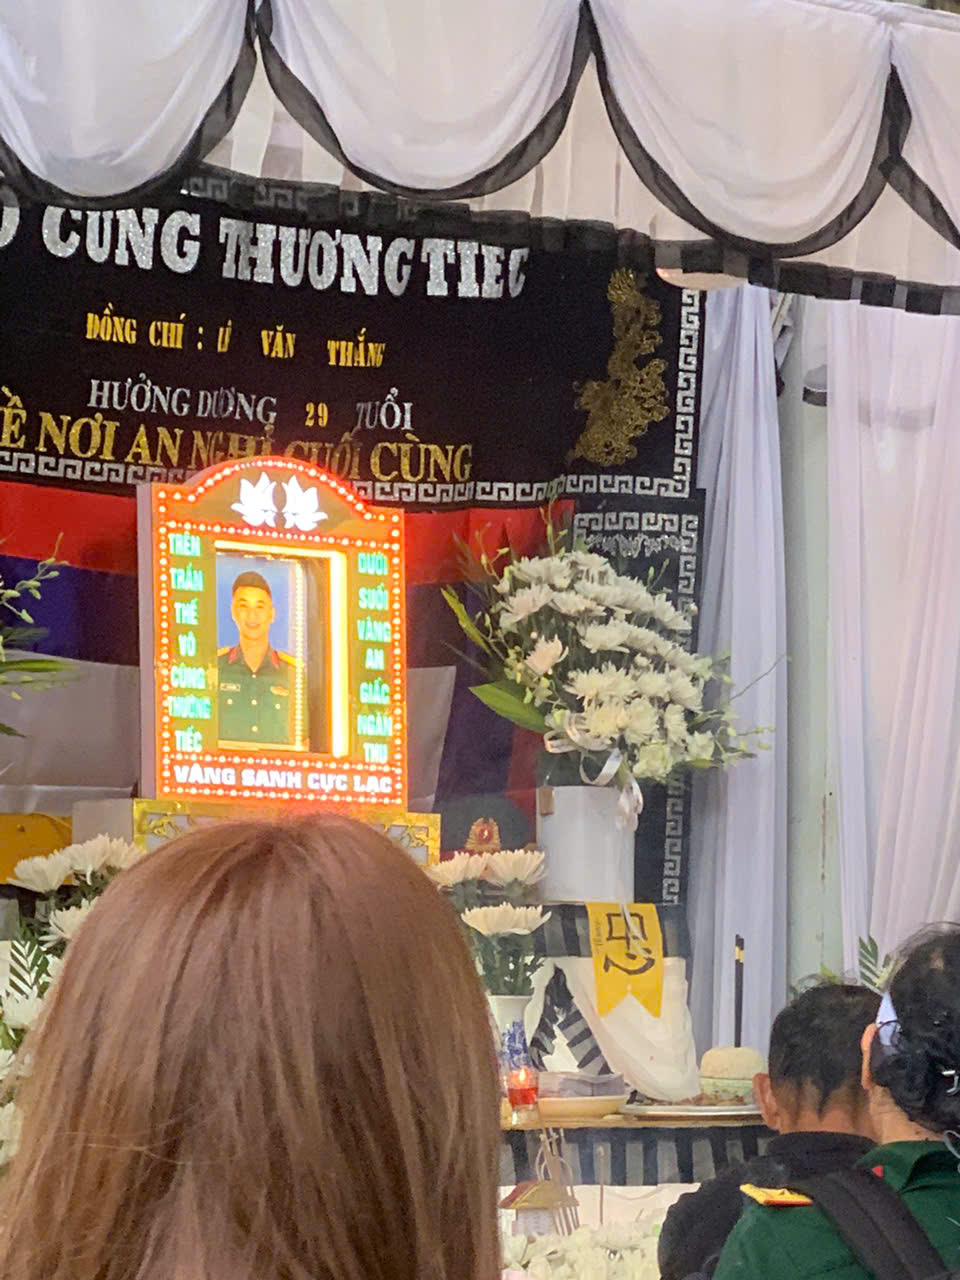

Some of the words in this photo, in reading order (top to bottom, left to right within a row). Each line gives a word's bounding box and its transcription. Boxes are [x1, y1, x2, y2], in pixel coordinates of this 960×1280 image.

[148, 313, 186, 349] CHÍ
[260, 324, 296, 359] VĂN
[327, 327, 386, 368] THẮNG
[87, 372, 191, 417] HƯỞNG
[305, 402, 329, 427] 29
[356, 386, 415, 431] TUỔI
[35, 412, 120, 460] NƠI
[124, 423, 184, 467] AN
[370, 432, 472, 482] CÙNG
[365, 647, 385, 670] AN
[241, 768, 301, 789] SANH
